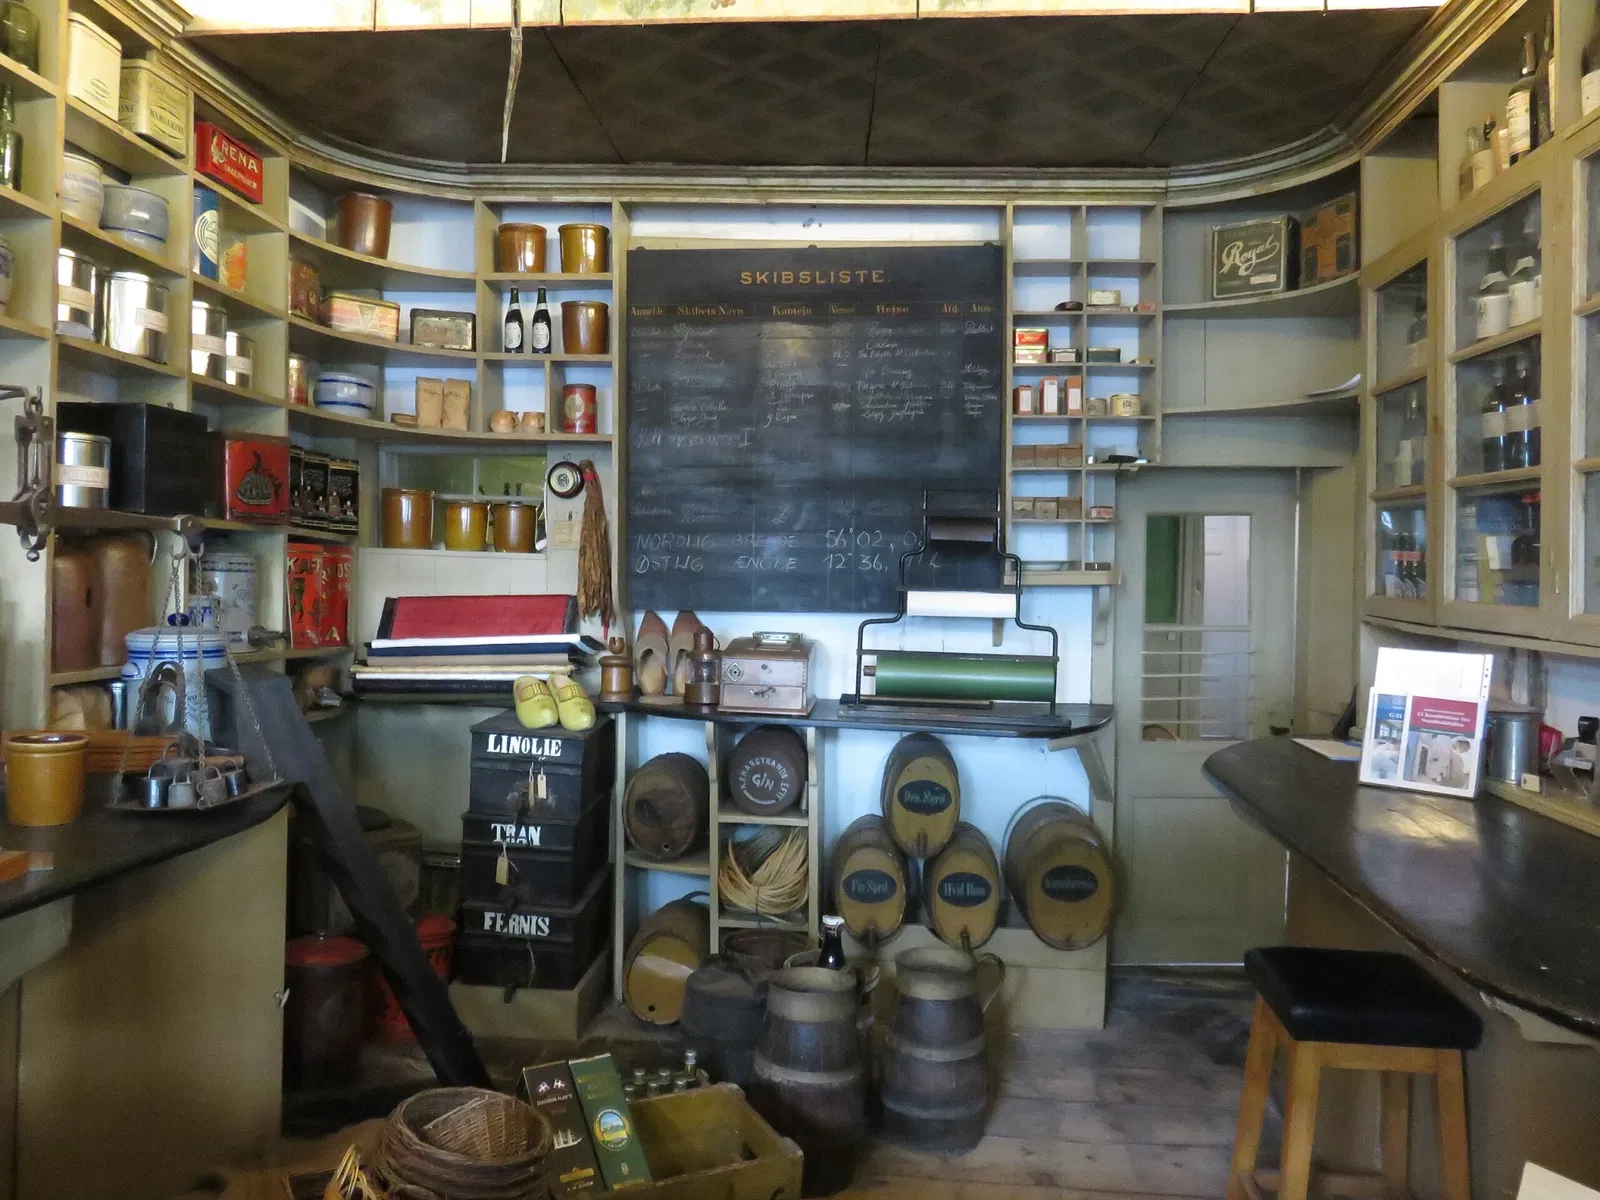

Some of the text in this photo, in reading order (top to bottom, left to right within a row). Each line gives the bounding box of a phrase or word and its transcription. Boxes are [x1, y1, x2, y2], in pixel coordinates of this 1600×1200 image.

[149, 108, 185, 135] MARGARINE
[221, 140, 259, 174] RENA
[1218, 234, 1280, 277] Royal
[676, 304, 744, 317] Skibets Navn
[635, 554, 704, 574] ØSTLIG
[486, 733, 562, 757] LINOLIE
[751, 771, 775, 791] GIN
[490, 823, 542, 846] TRAN
[866, 879, 889, 895] Sprit
[943, 881, 965, 897] Hvid
[483, 911, 550, 937] FERNIS
